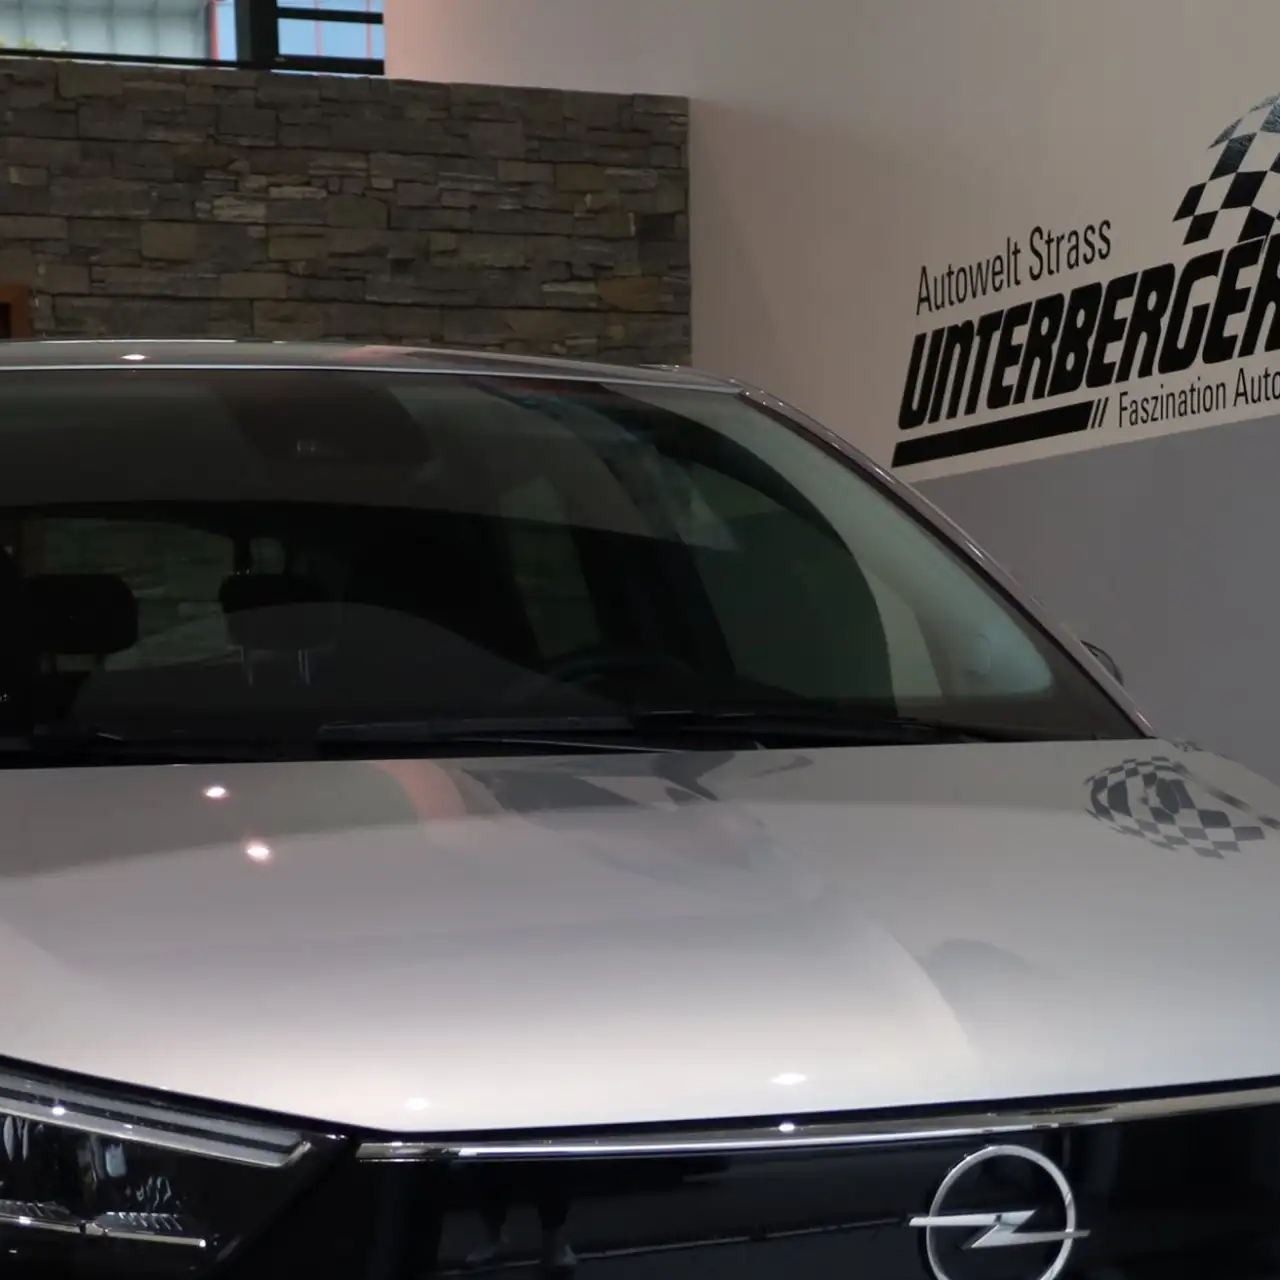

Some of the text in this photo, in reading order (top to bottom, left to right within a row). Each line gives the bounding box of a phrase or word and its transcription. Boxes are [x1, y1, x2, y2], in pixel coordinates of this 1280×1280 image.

[916, 219, 1112, 316] Autowelt Strass
[1119, 373, 1227, 428] Faszination
